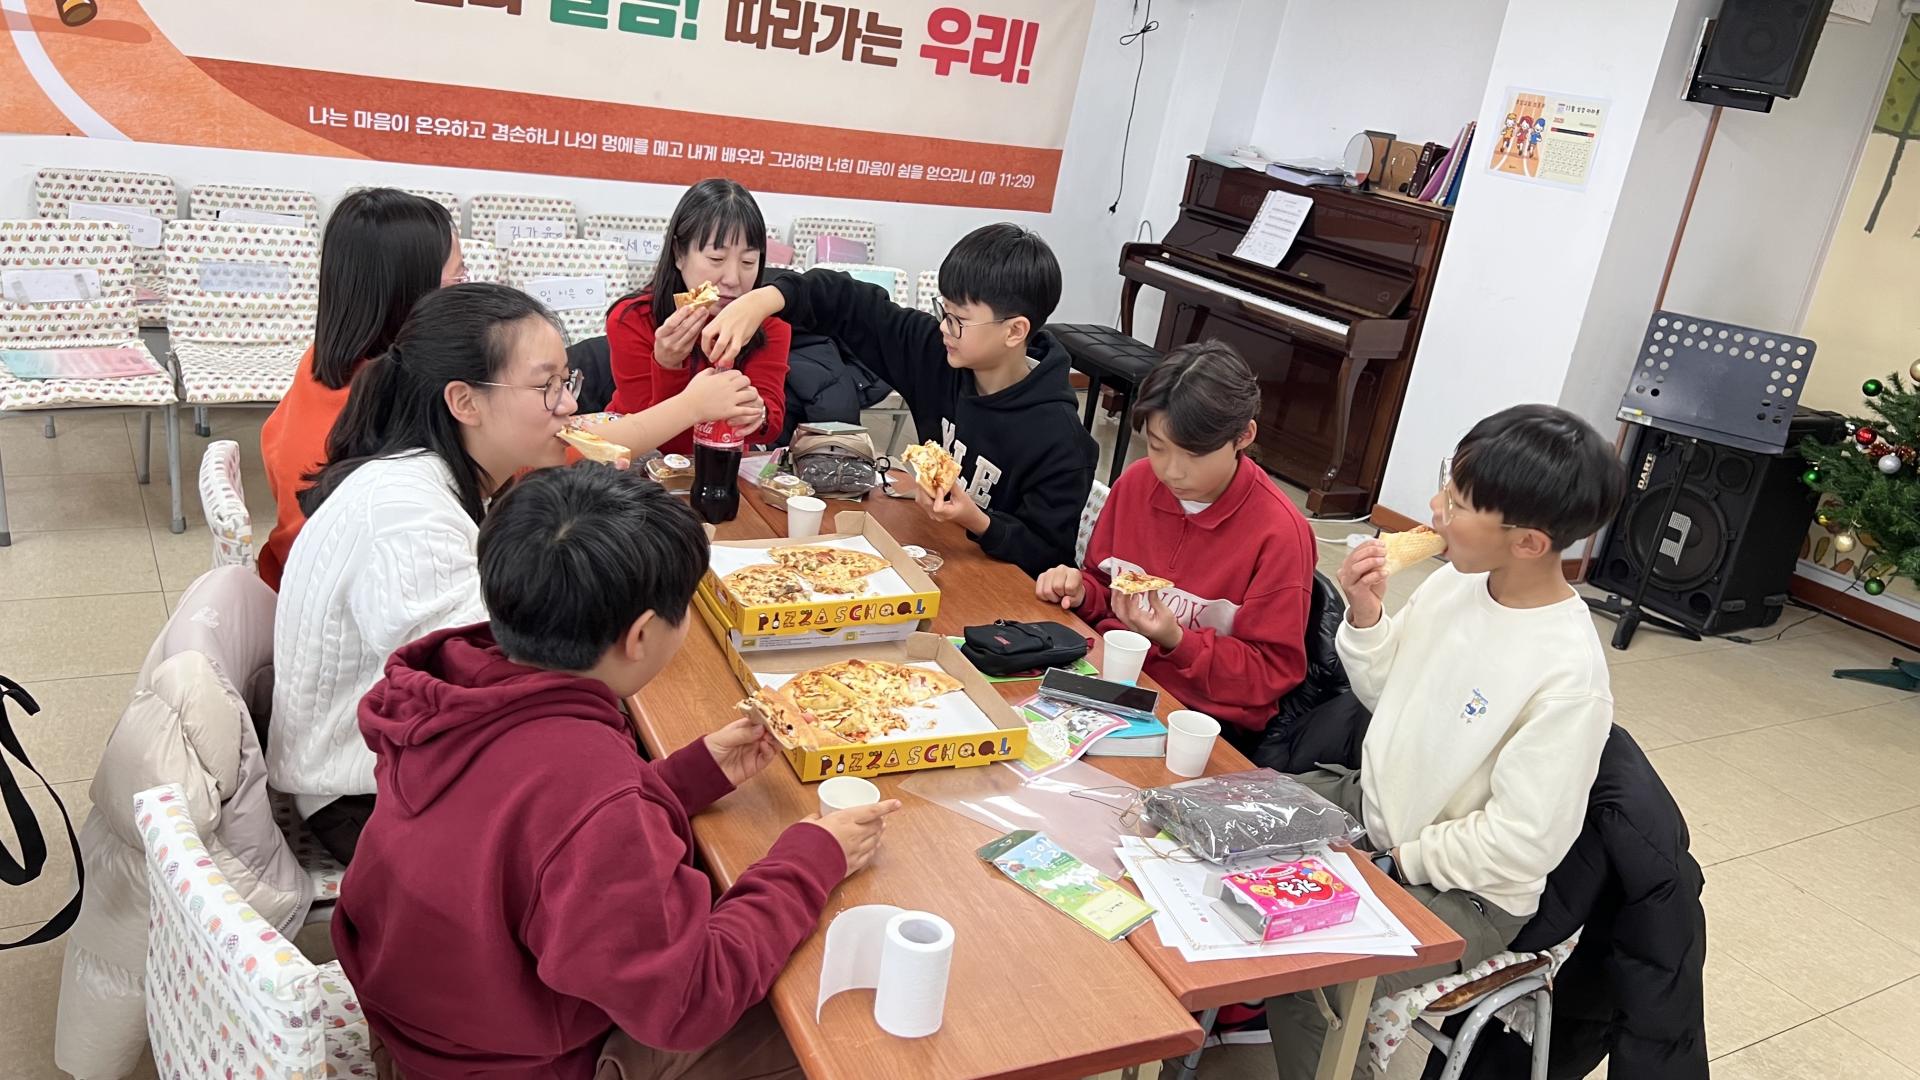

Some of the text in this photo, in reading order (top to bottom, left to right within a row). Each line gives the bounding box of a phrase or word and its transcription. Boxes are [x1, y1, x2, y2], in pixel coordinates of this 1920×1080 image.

[725, 0, 902, 67] 따라가는
[920, 7, 1039, 84] 우리!
[309, 106, 1035, 189] 나는 마음이 온유하고 겸손하니 나의 멍에를 메고 내게 배우라 그리하면 너희 마음이 쉼을 얻으리니 (마 11:29)
[1637, 452, 1656, 490] DART
[758, 599, 926, 631] PIZZA SCHOOL
[820, 737, 1012, 776] PIZZA SCHOOL
